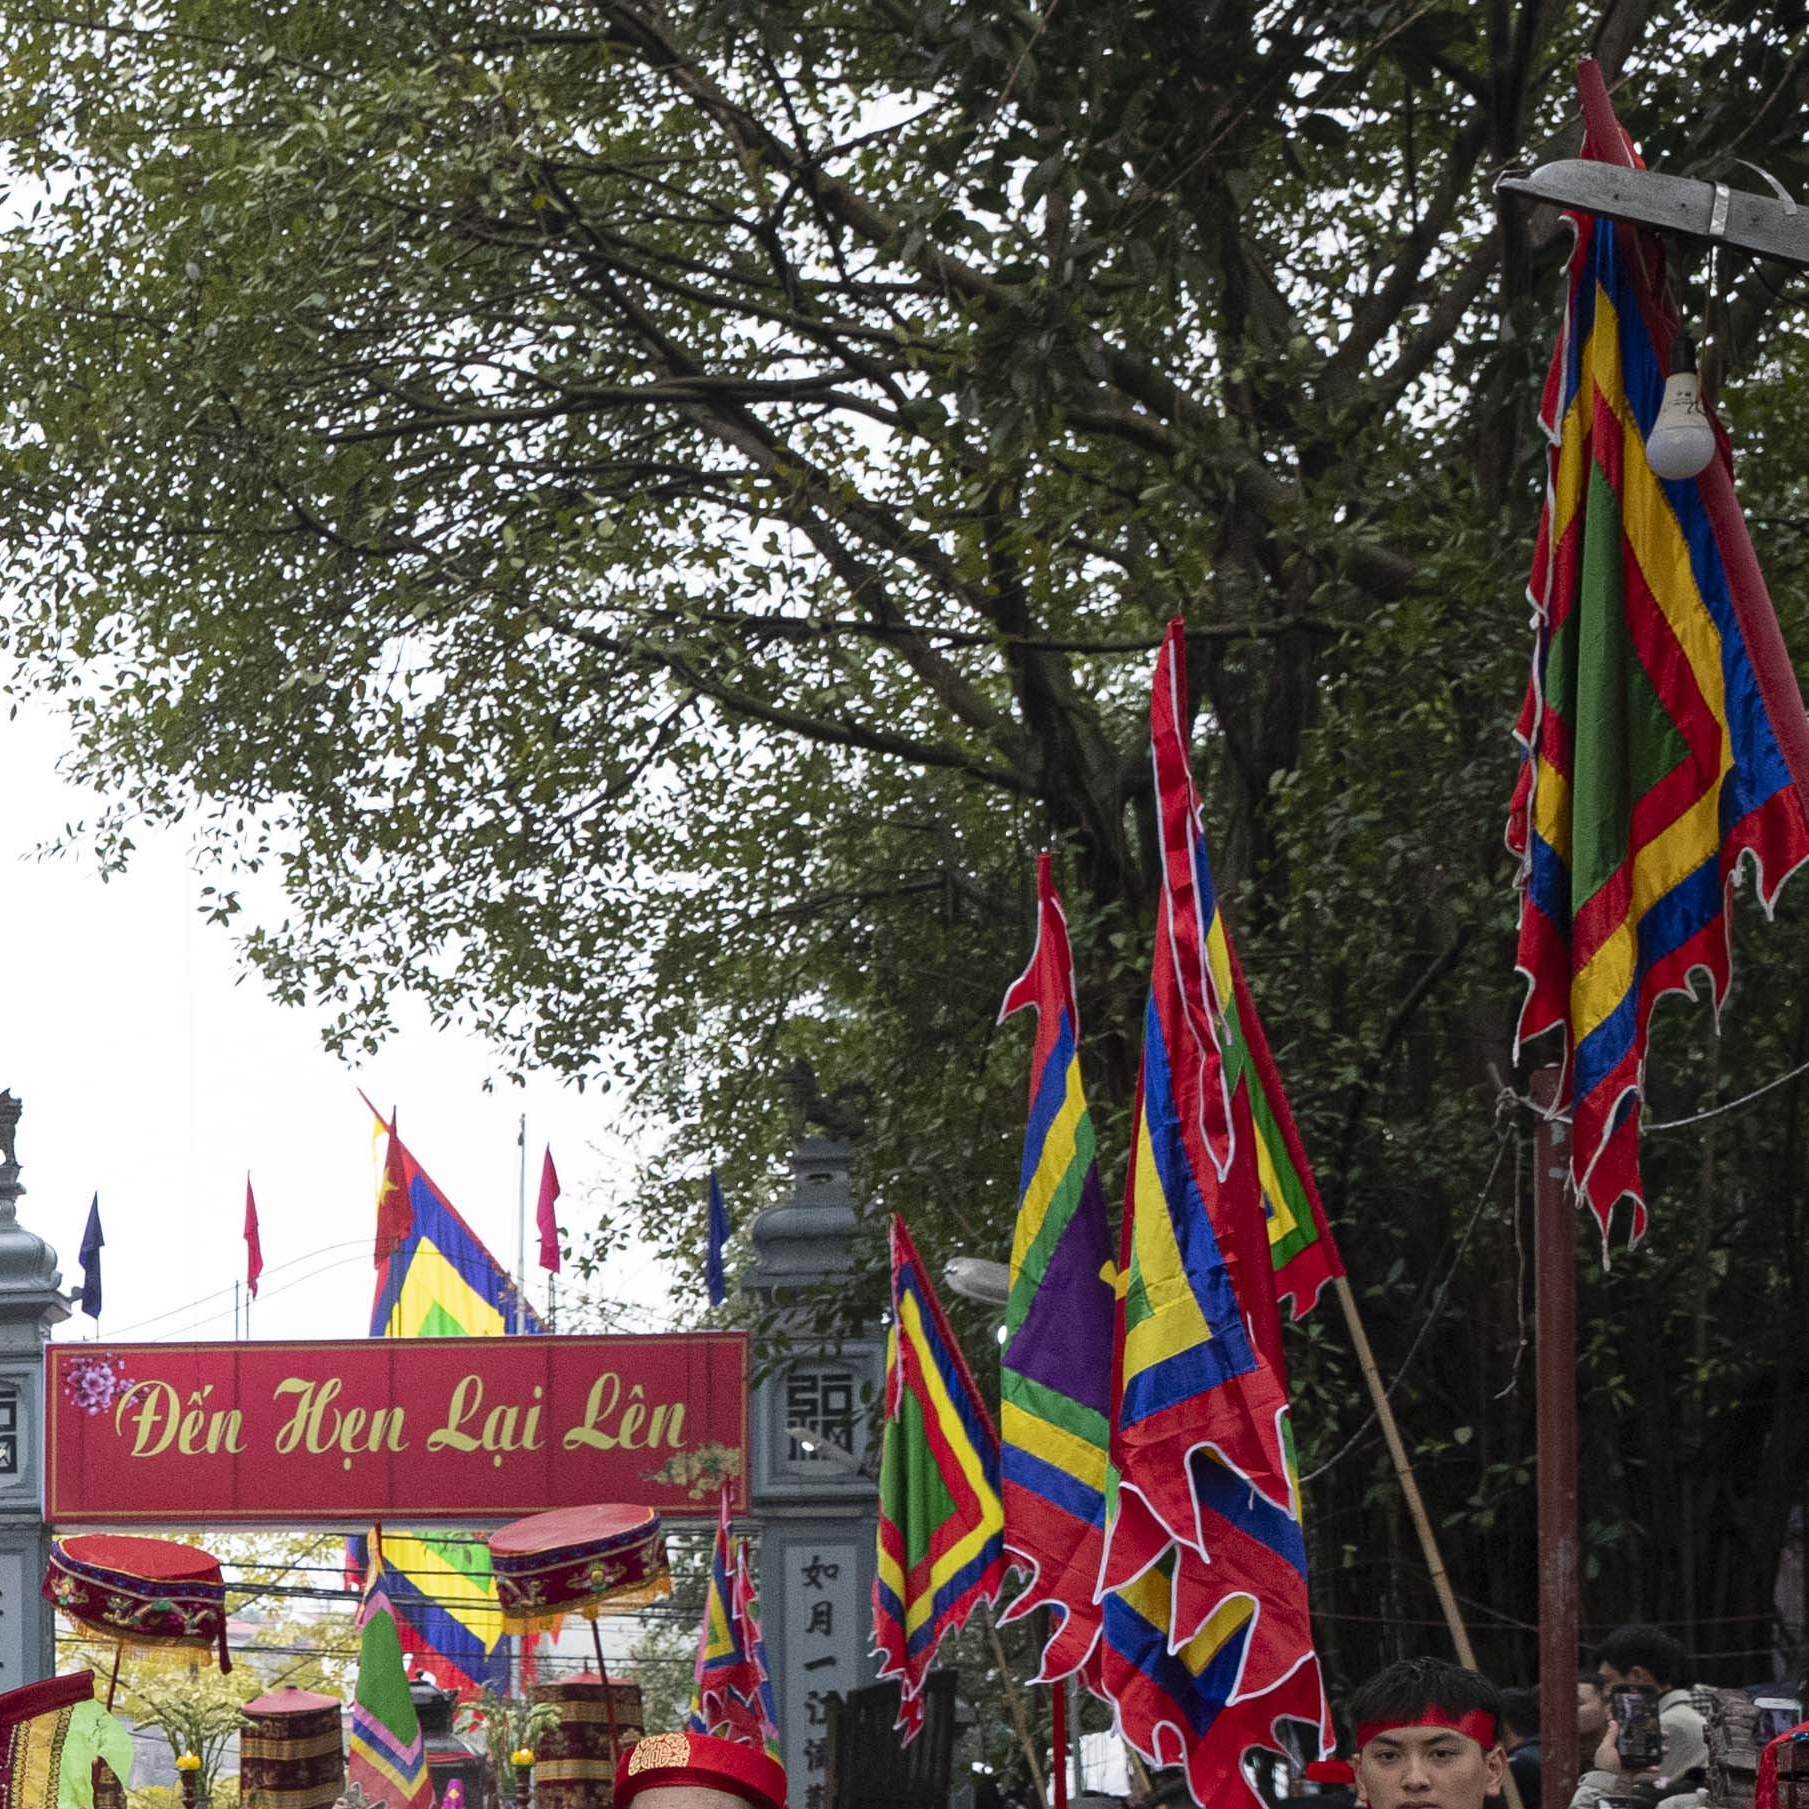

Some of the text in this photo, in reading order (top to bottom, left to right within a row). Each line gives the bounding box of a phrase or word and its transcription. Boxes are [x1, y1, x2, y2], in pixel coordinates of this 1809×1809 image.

[115, 1372, 689, 1470] Đến Hẹn Lại Lên
